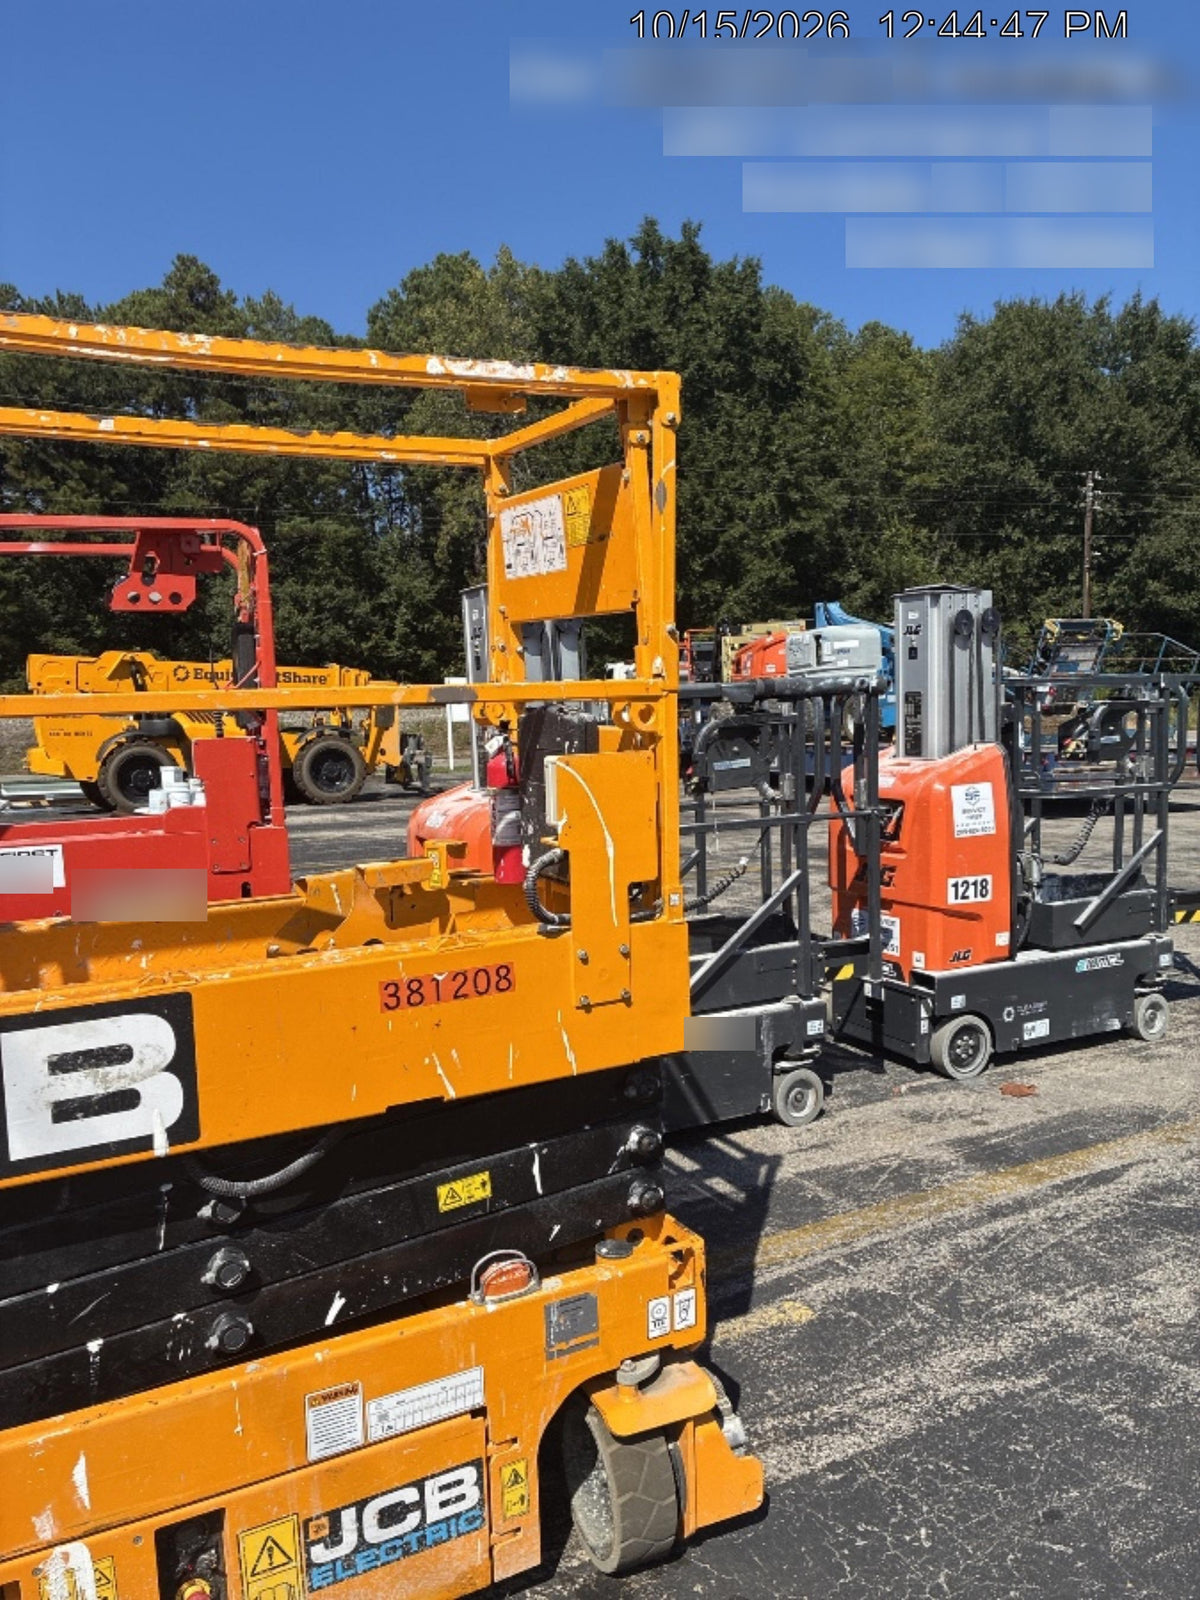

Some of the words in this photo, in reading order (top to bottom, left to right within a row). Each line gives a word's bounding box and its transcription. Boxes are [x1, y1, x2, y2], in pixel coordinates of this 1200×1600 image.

[950, 877, 989, 900] 1218
[383, 964, 513, 1011] 381208
[310, 1466, 481, 1563] JCB
[310, 1508, 484, 1589] ELECTRIC
